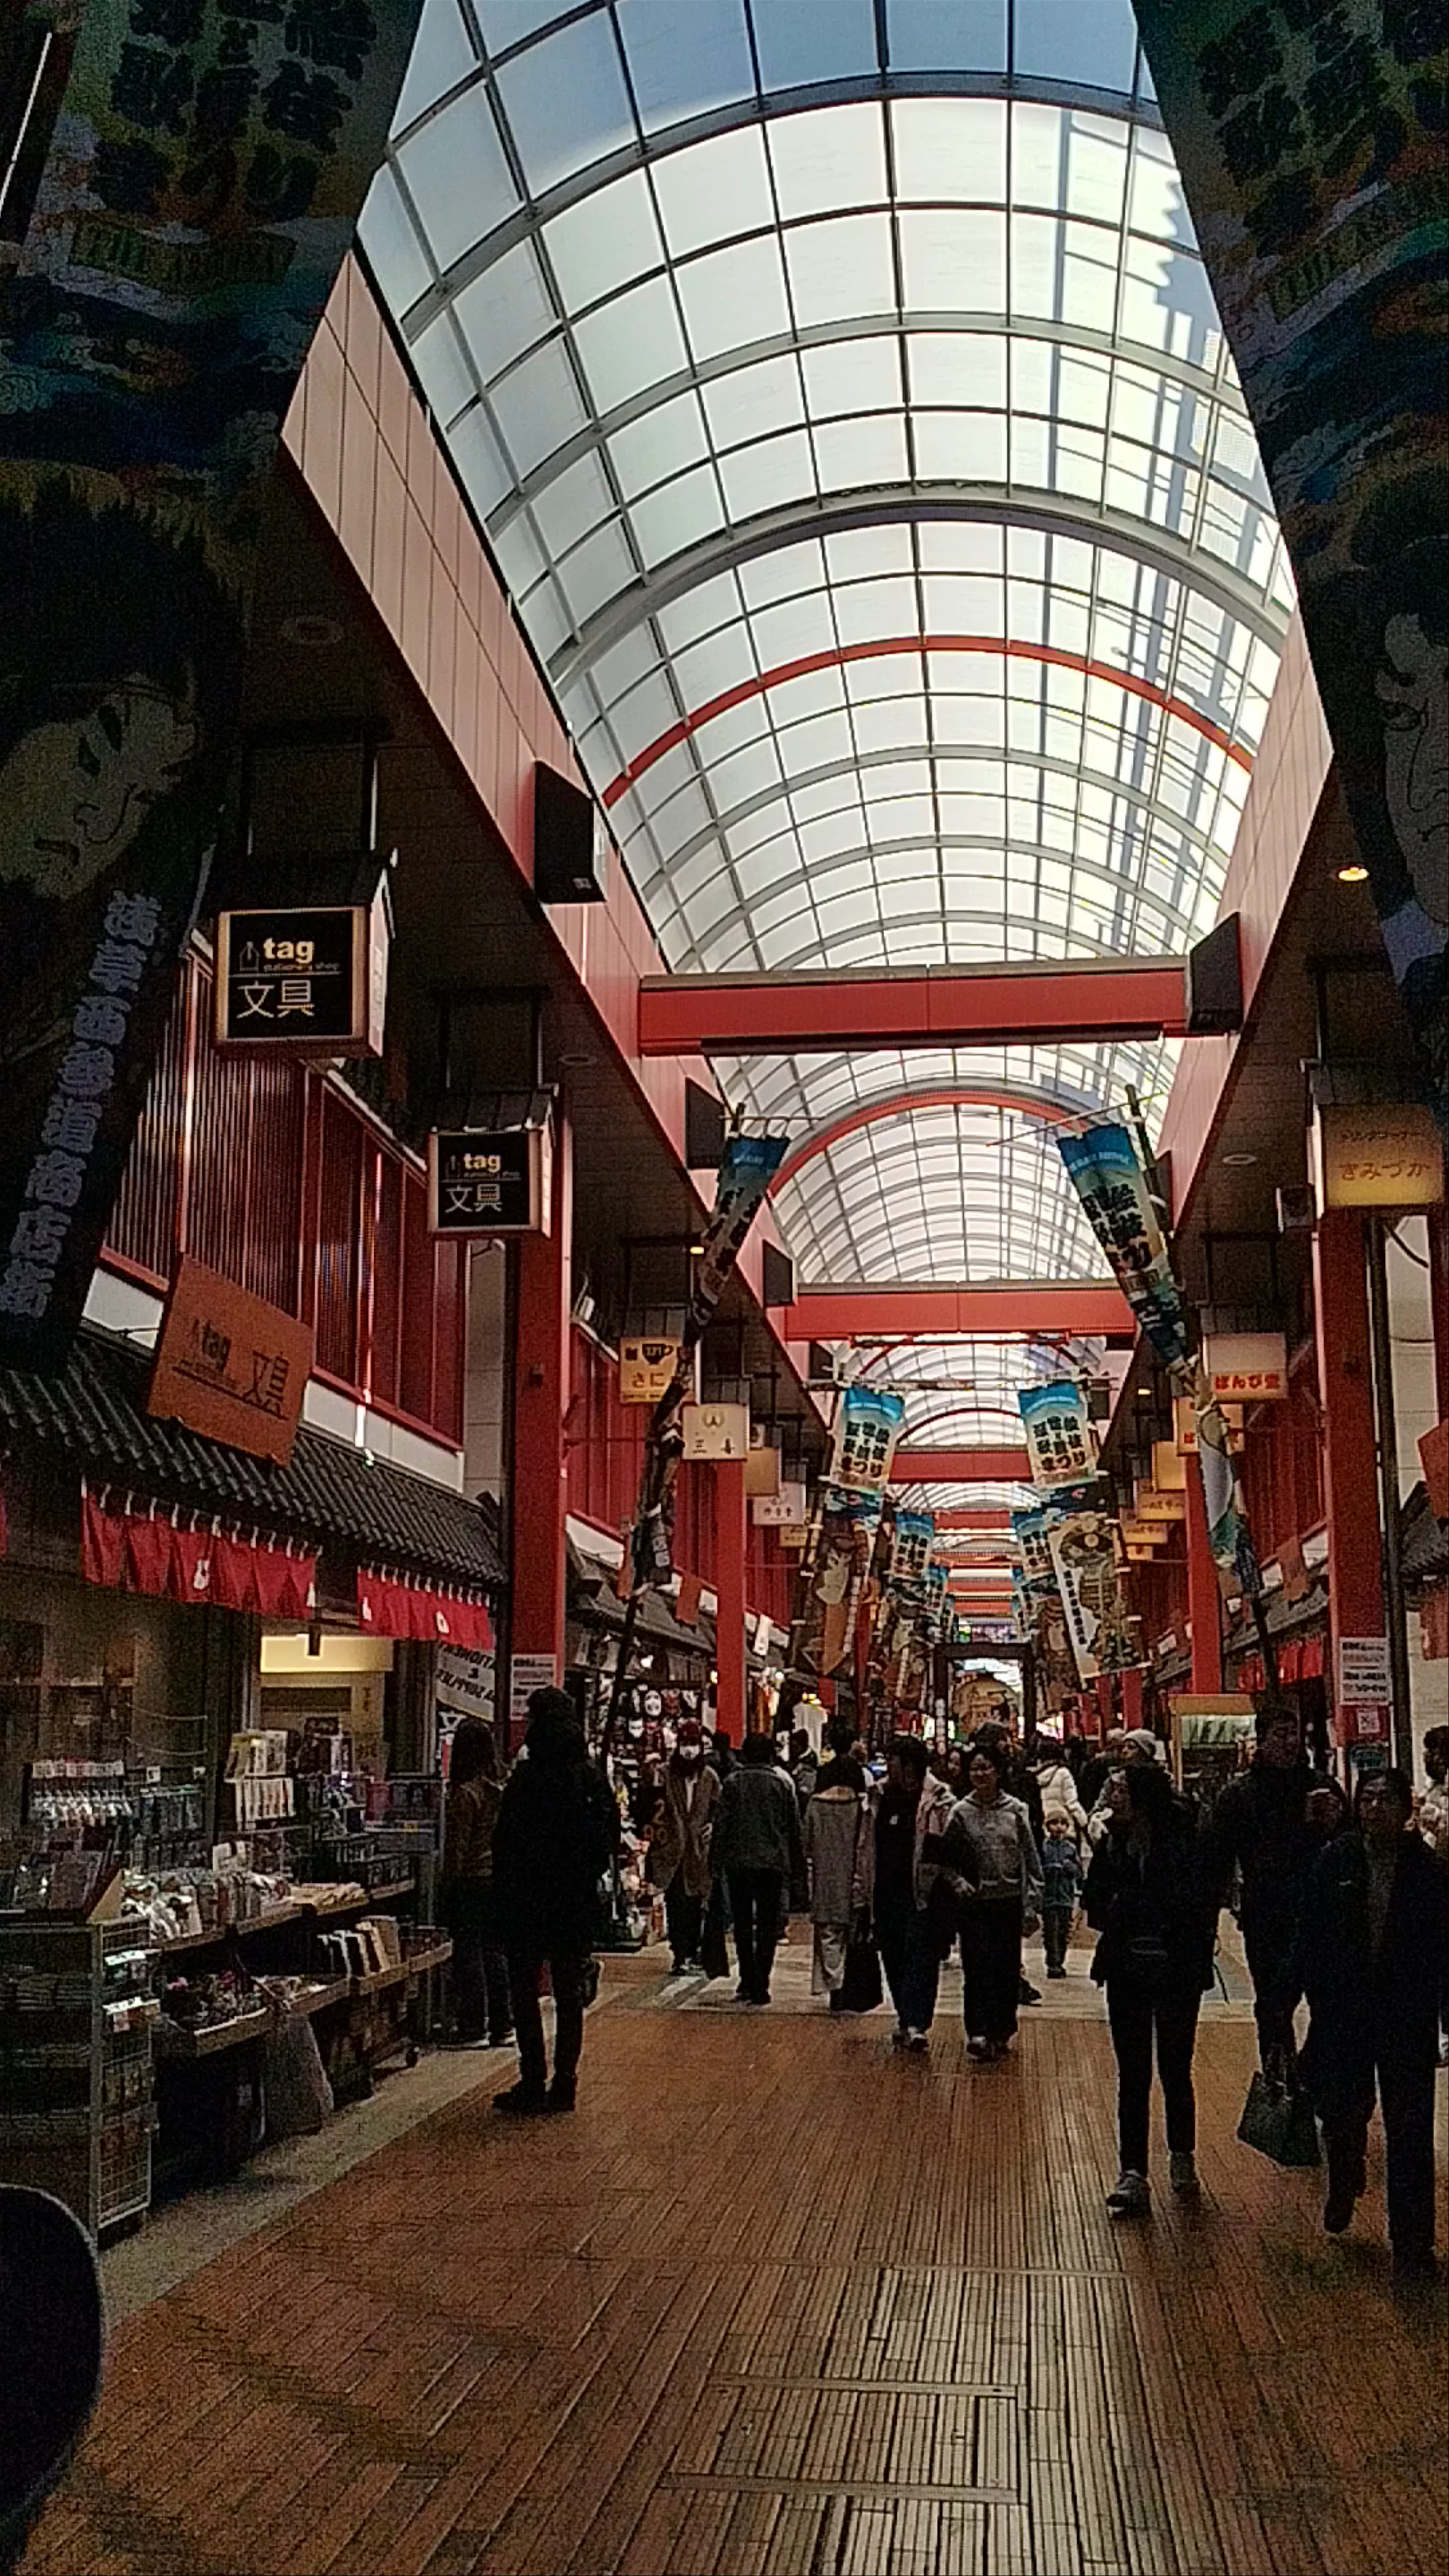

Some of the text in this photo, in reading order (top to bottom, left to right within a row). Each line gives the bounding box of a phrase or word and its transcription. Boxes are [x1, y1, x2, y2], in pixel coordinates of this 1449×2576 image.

[263, 937, 315, 964] tag
[236, 980, 315, 1019] 文具
[463, 1153, 501, 1173] tag
[444, 1183, 503, 1213] 文具
[243, 1349, 290, 1420] 文具
[842, 1456, 882, 1477] まつり
[1042, 1451, 1085, 1470] まつり
